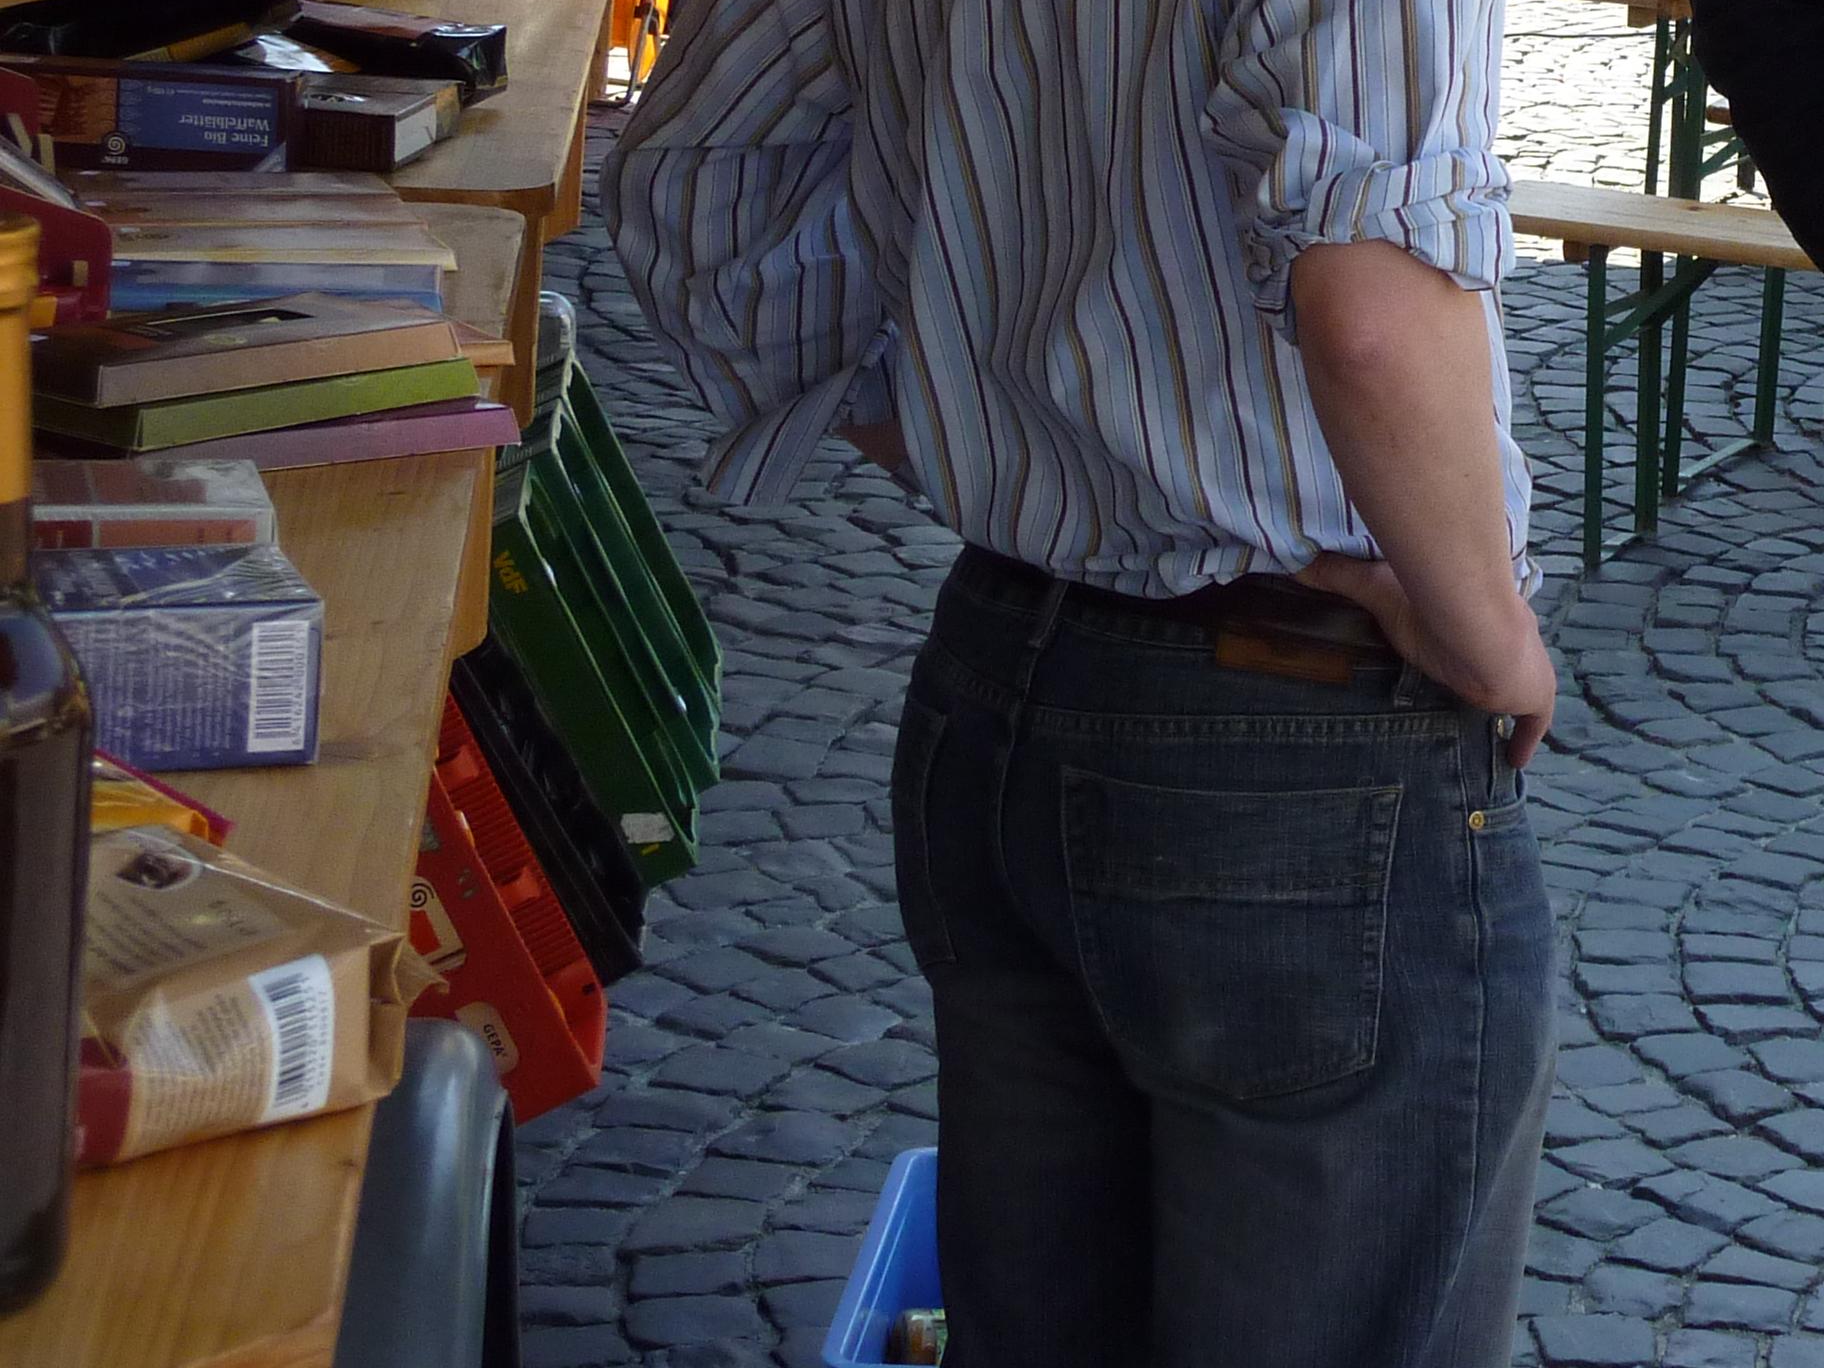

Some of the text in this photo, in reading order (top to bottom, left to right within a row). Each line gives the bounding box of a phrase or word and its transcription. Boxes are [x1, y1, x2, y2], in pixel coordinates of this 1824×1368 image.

[178, 114, 270, 132] Waffelblätter
[204, 131, 269, 147] Feine Bio
[482, 1023, 504, 1057] GEPA
